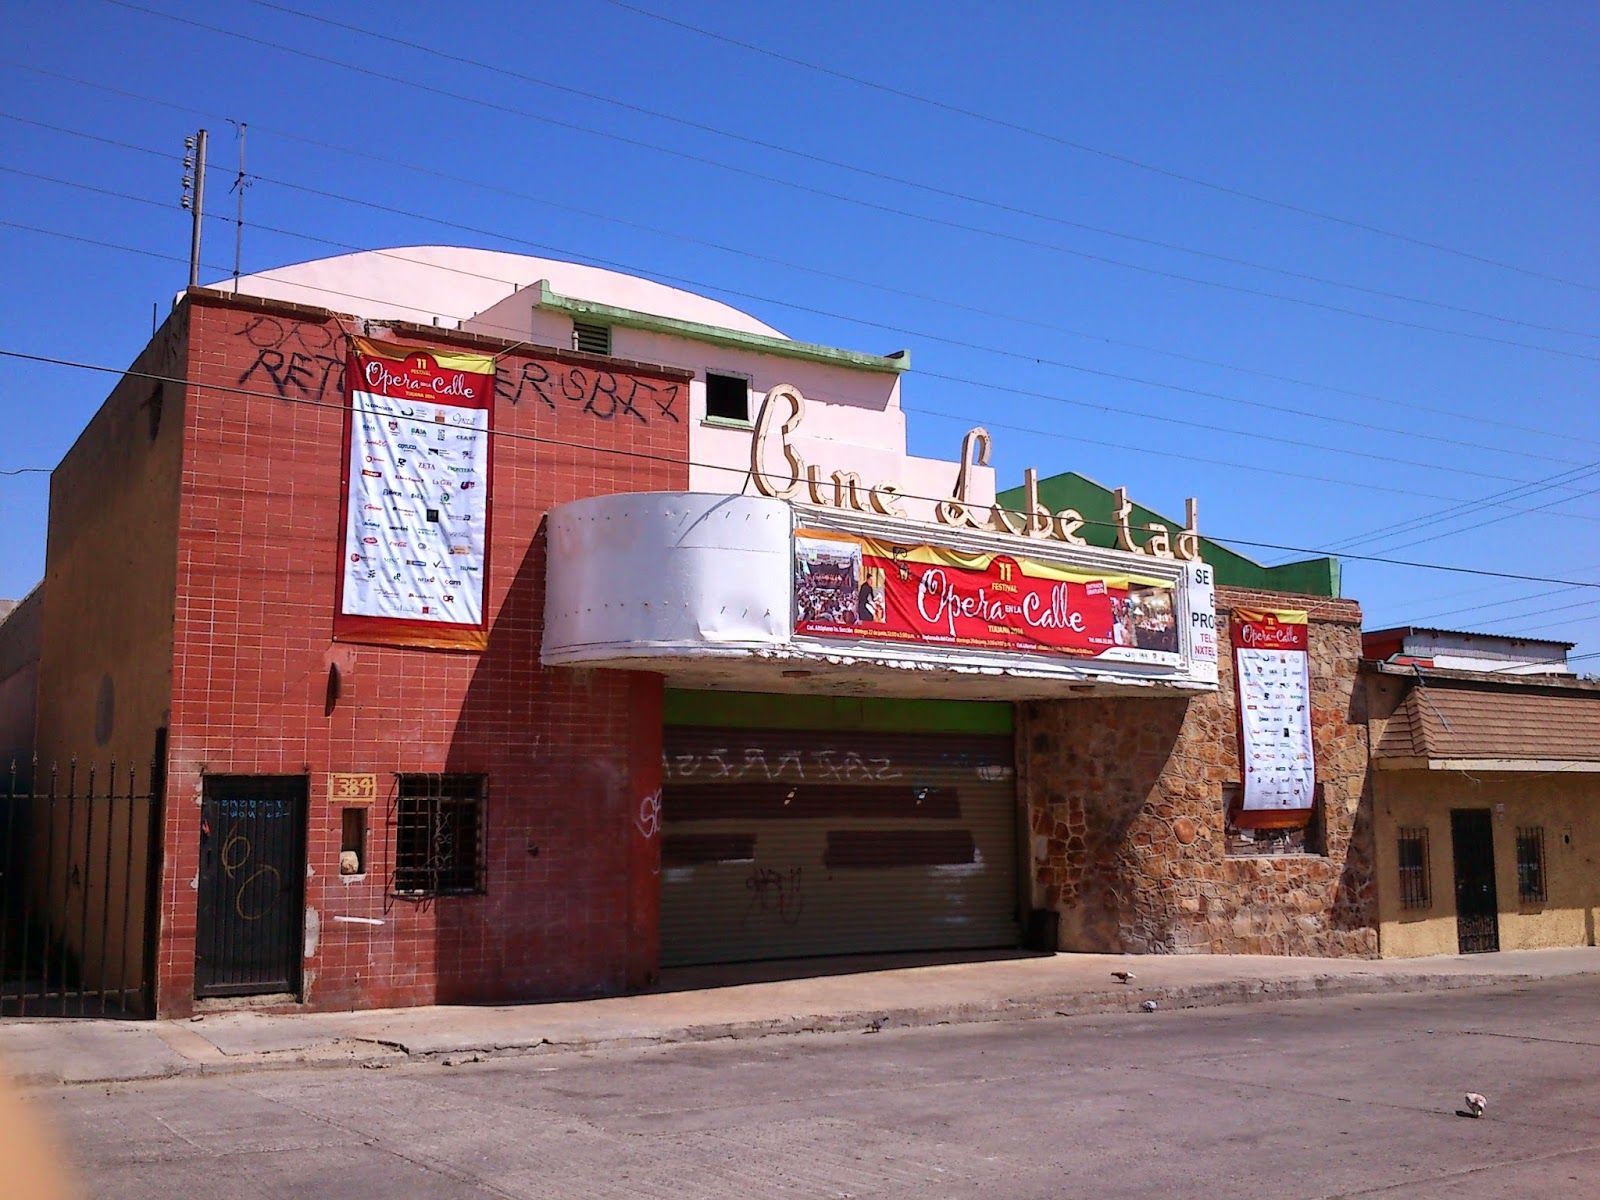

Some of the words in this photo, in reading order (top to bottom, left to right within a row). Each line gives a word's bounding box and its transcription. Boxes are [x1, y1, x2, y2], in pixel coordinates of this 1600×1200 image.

[431, 373, 475, 399] Calle
[751, 383, 907, 521] Cine
[999, 562, 1012, 582] 11
[1195, 569, 1209, 585] SE
[992, 582, 1018, 593] FESTIVAL
[1005, 604, 1014, 613] EN
[1014, 605, 1022, 614] LA
[1022, 582, 1086, 632] Calle
[987, 624, 1010, 634] TIJUANA
[1010, 626, 1024, 635] 2014
